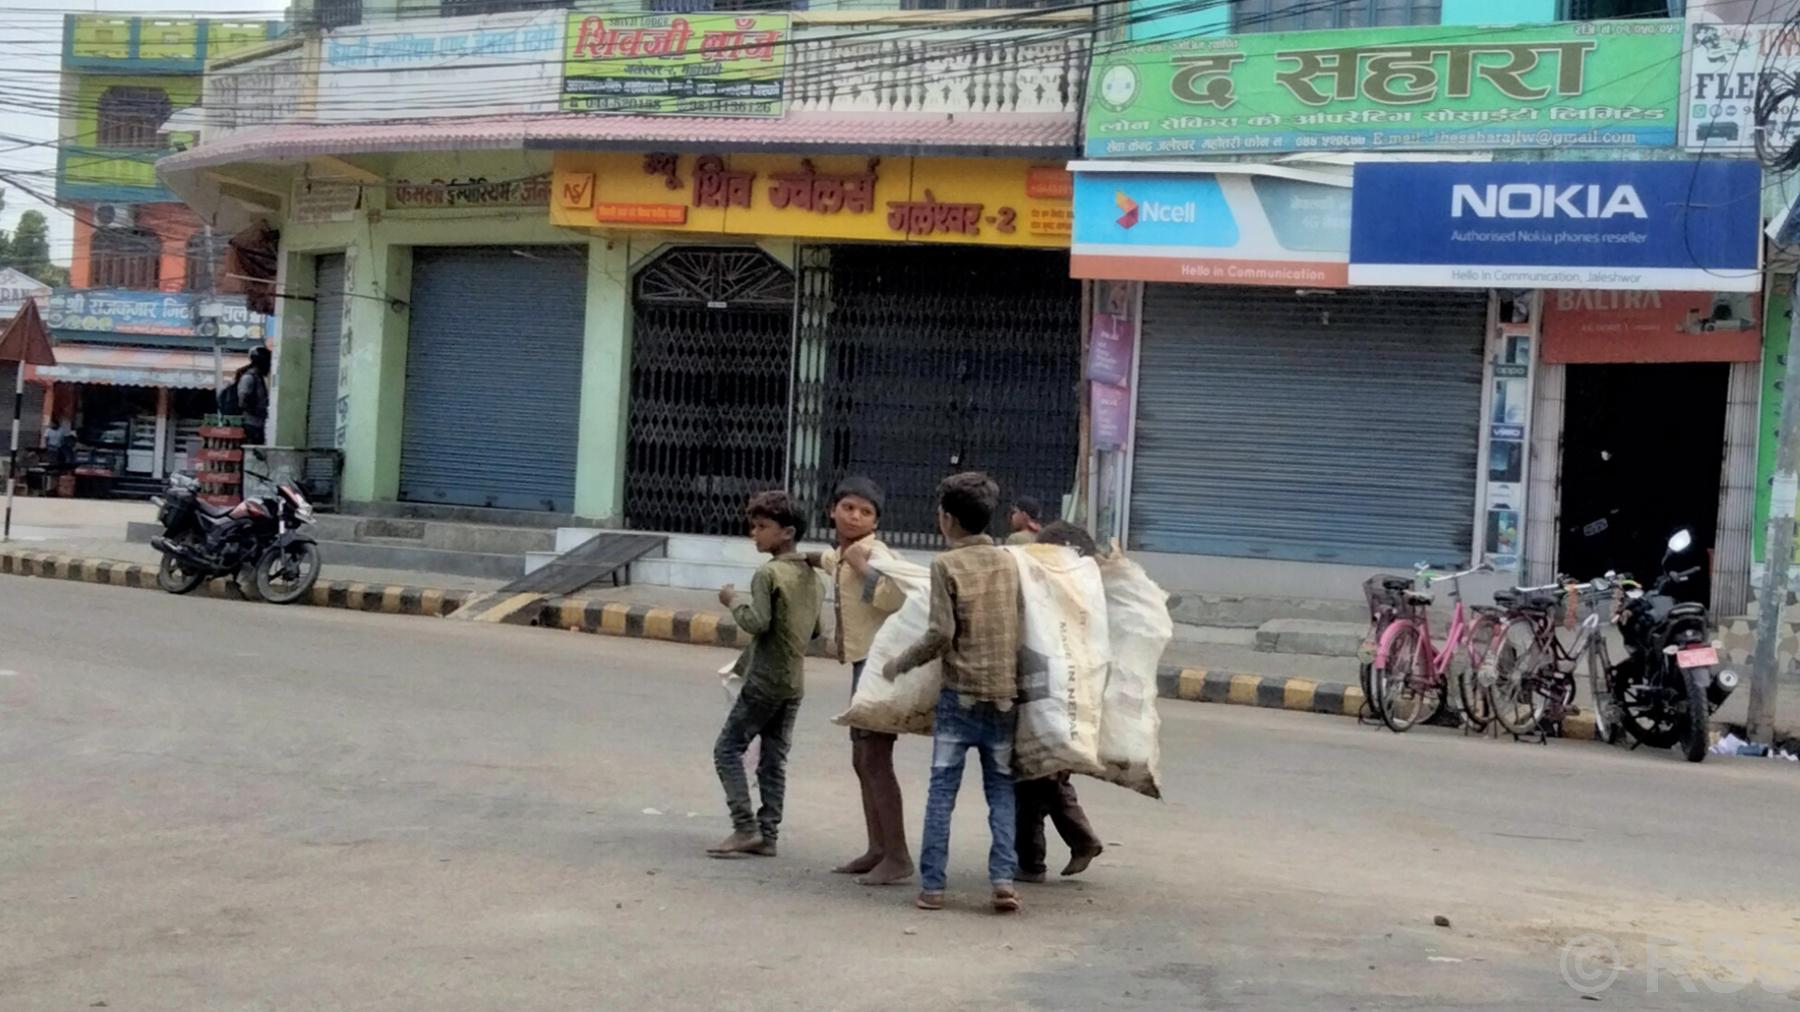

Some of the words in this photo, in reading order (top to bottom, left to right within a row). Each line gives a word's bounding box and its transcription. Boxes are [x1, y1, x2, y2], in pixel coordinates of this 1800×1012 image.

[574, 16, 694, 59] शिवजी
[1169, 52, 1247, 110] द
[1275, 40, 1597, 106] सहारा
[693, 154, 756, 207] शिव
[1142, 200, 1196, 223] Ncell
[1451, 184, 1649, 219] NOKIA
[1451, 229, 1516, 243] Authorised
[1518, 230, 1552, 243] Nokia
[1554, 231, 1600, 245] phones
[1602, 231, 1648, 244] reseller
[1181, 264, 1210, 278] Hello
[1213, 265, 1224, 278] in
[1228, 265, 1325, 281] Communication
[1452, 269, 1479, 281] Hello
[1066, 664, 1077, 684] IN
[1065, 688, 1081, 742] NEPAL
